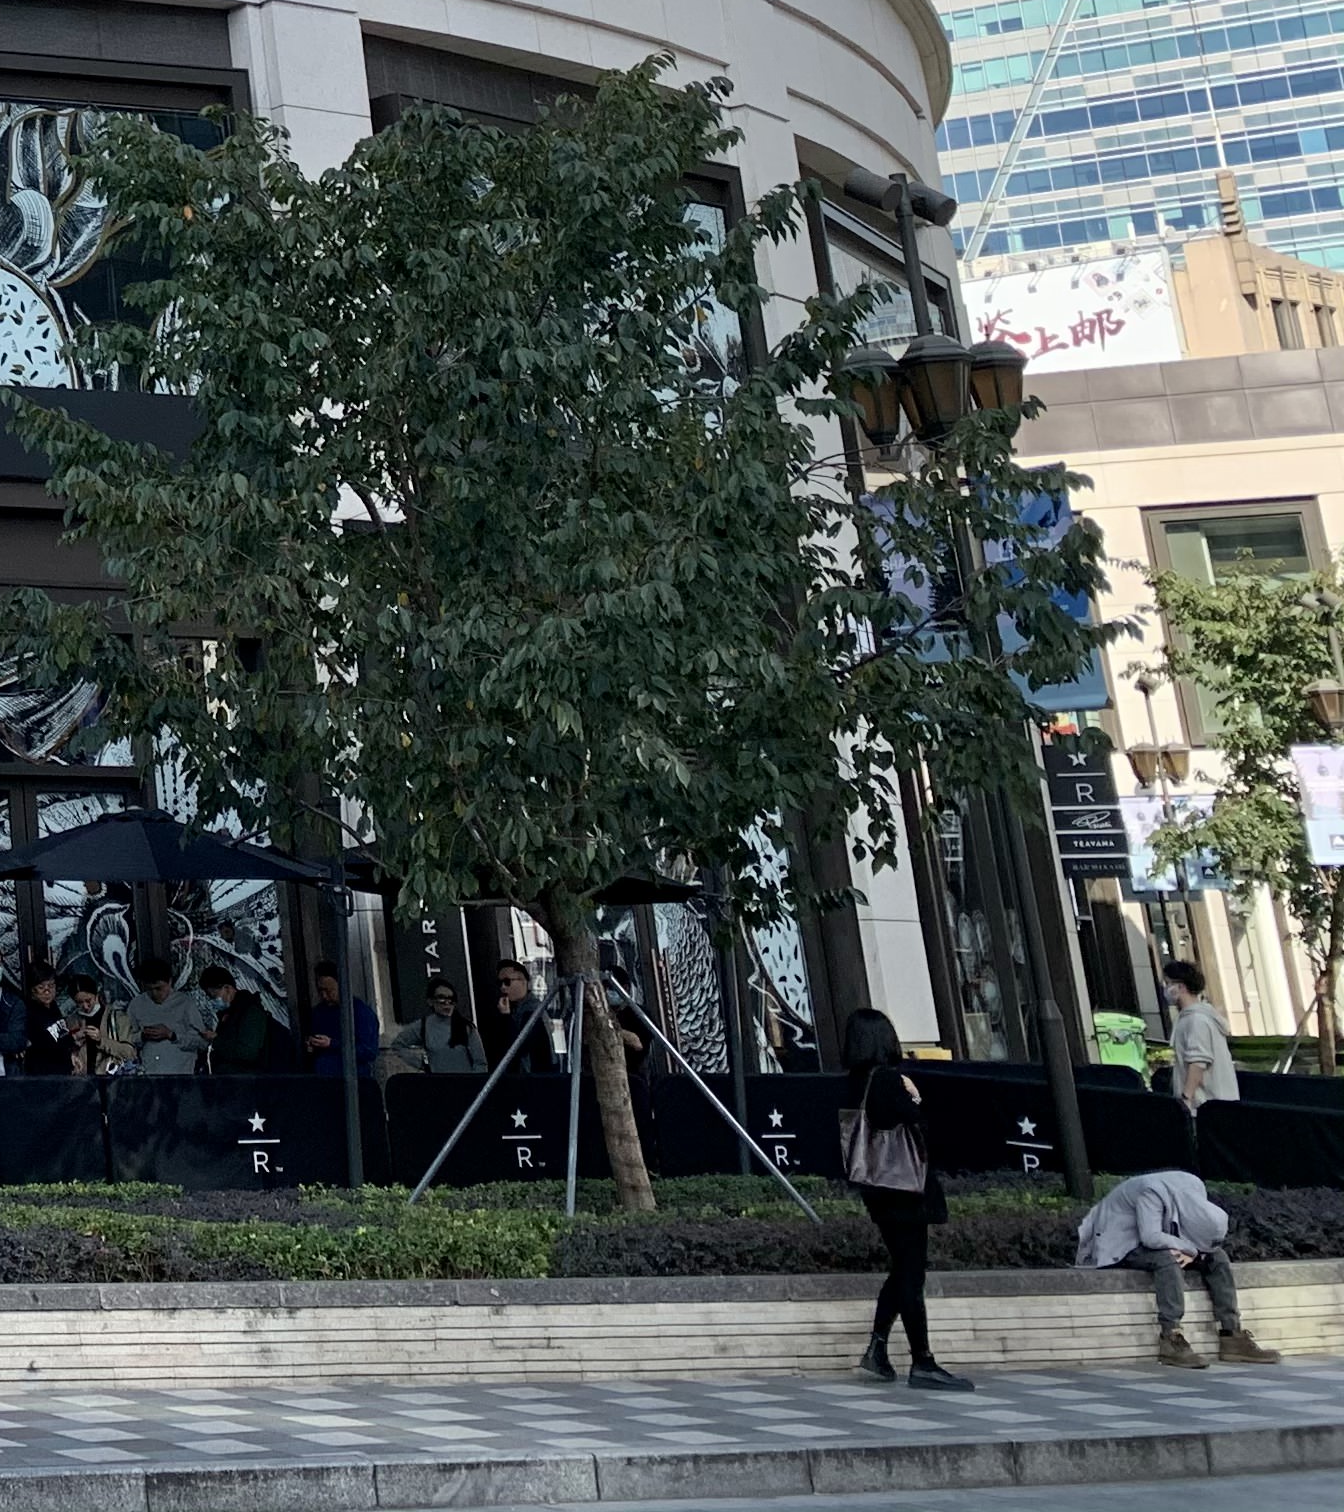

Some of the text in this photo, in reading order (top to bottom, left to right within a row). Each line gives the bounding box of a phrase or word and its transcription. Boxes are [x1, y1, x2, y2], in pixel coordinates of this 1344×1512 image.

[1075, 783, 1096, 803] R
[253, 1151, 270, 1173] R
[517, 1147, 534, 1168] R
[774, 1145, 790, 1166] R
